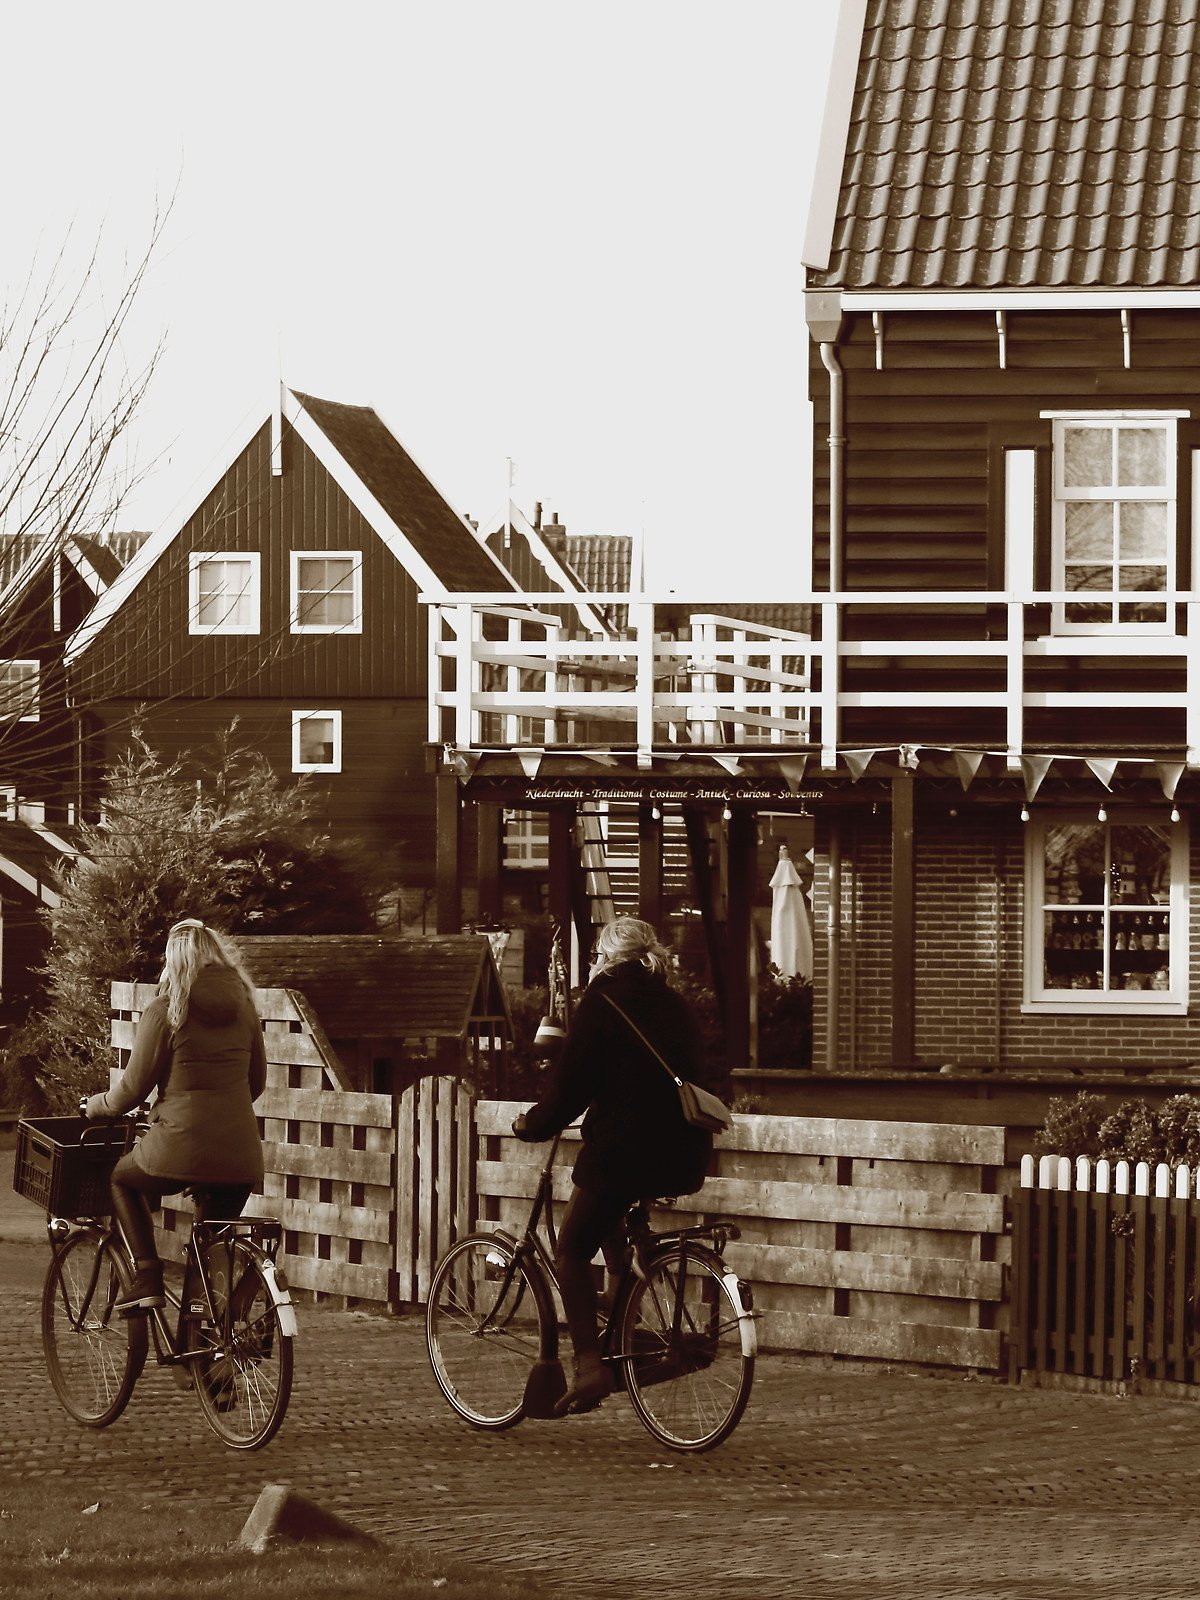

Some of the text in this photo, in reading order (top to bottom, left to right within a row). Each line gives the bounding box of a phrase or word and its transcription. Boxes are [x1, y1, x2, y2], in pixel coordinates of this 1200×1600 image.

[591, 788, 643, 798] Traditional
[649, 789, 688, 798] Costume
[695, 788, 731, 800] Antiek
[735, 789, 771, 798] Curiosa
